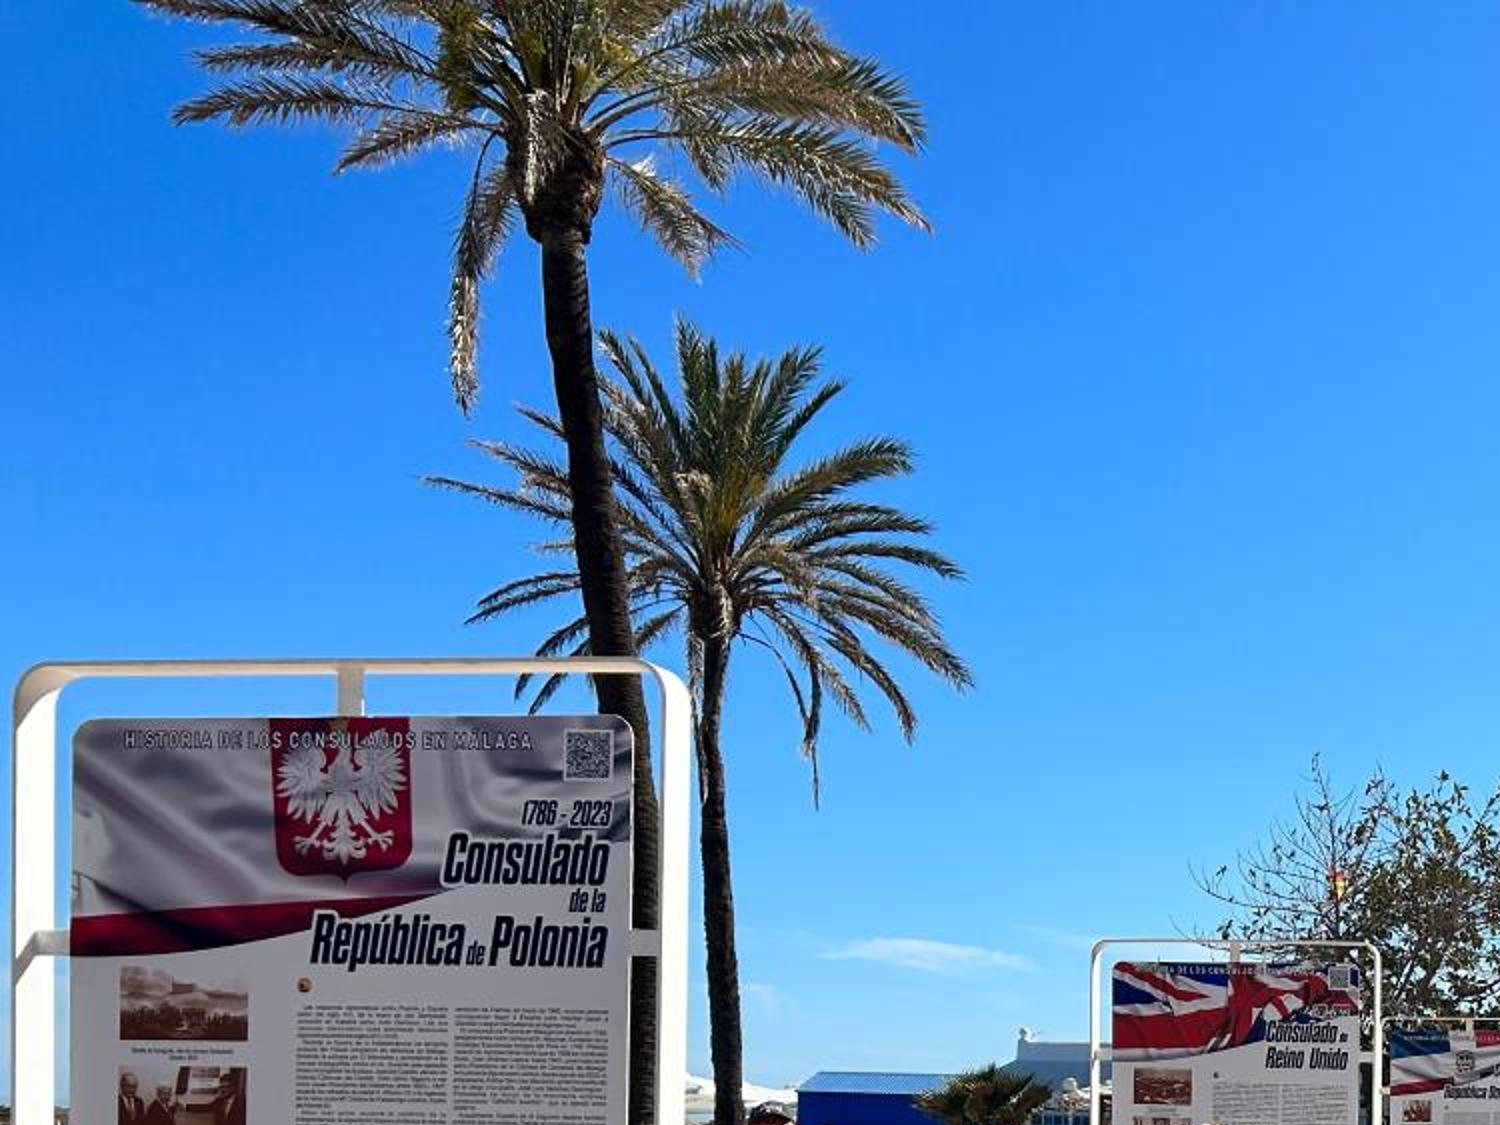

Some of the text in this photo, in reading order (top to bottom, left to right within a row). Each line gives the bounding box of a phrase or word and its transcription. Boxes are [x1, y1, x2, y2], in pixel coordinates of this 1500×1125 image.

[247, 730, 283, 750] LOS
[422, 730, 448, 751] EN
[521, 799, 559, 826] 1786
[569, 800, 613, 827] 2023
[443, 831, 611, 886] Consulado
[568, 887, 607, 913] de la
[310, 912, 609, 973] República de Polonia
[1265, 1019, 1338, 1043] Consulado
[1265, 1046, 1348, 1071] Reino Unido
